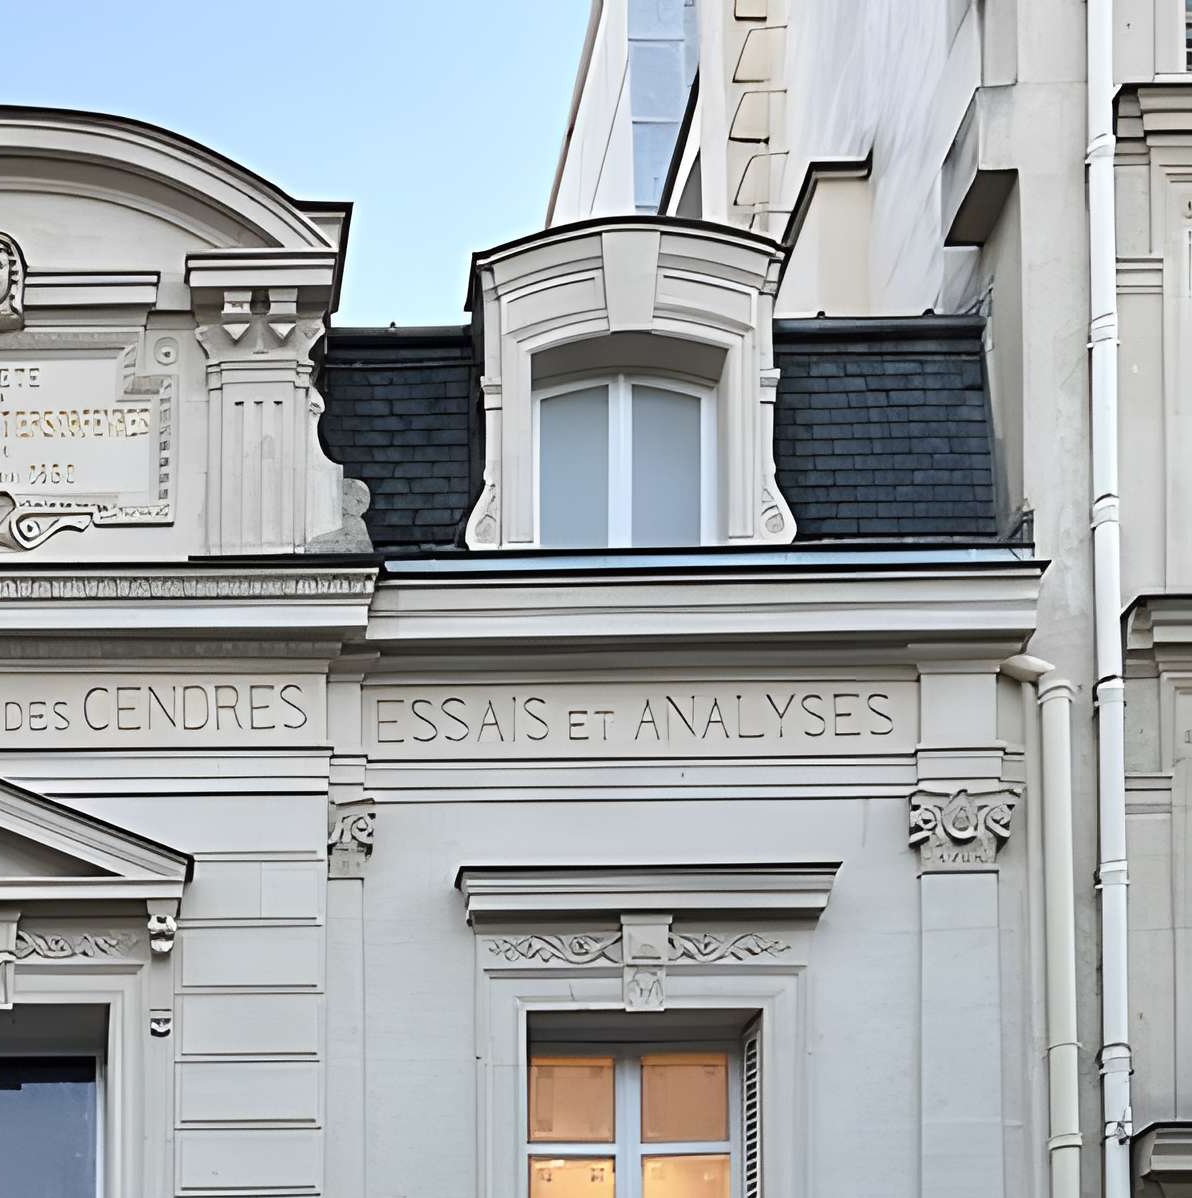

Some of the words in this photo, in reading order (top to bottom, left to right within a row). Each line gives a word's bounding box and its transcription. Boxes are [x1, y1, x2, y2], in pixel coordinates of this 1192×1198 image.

[4, 701, 71, 732] DES
[83, 683, 309, 732] CENDRES
[376, 696, 549, 744] ESSAIS
[568, 711, 615, 742] ET
[634, 692, 894, 741] ANALYSES
